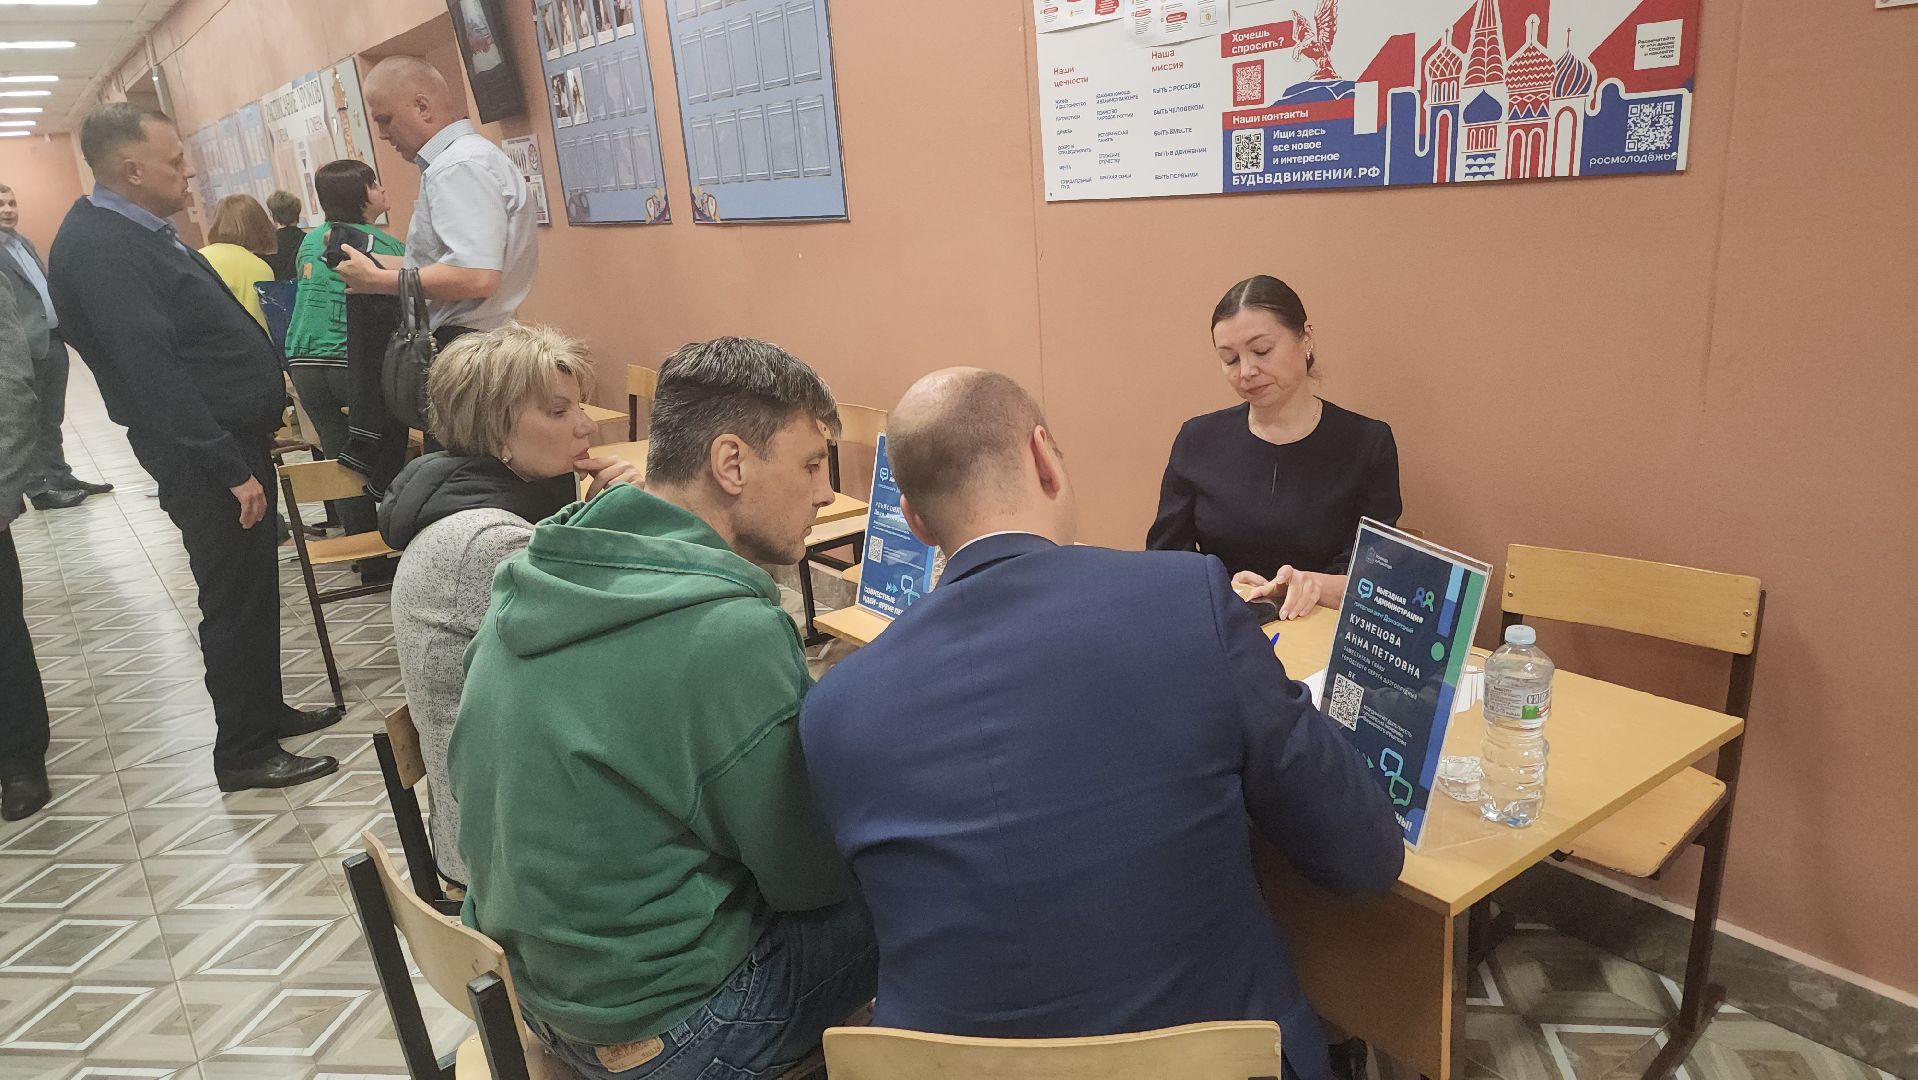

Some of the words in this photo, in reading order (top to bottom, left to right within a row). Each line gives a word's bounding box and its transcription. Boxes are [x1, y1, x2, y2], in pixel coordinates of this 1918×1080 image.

[1232, 30, 1270, 43] Хочешь
[1232, 36, 1284, 54] спросить?
[1151, 49, 1175, 60] Наша
[1053, 66, 1074, 76] Наши
[1151, 61, 1184, 72] миссия
[1054, 76, 1089, 88] ценности
[1169, 104, 1204, 114] ЧЕЛОВЕКОМ
[1232, 114, 1260, 124] Наши
[1261, 110, 1309, 122] контакты
[1273, 129, 1295, 140] Ищи
[1297, 127, 1326, 138] здесь
[1273, 143, 1289, 152] все
[1291, 141, 1322, 150] новое
[1273, 157, 1279, 165] и
[1280, 152, 1340, 165] интересное
[1590, 152, 1671, 168] росмолодёжь
[1232, 166, 1380, 186] БУДЬВДВИЖЕНИИ.РФ
[1376, 586, 1406, 606] ВЫЕЗДНАЯ
[1374, 596, 1424, 624] АДМИНИСТРАЦИЯ
[1350, 613, 1400, 648] КУЗНЕЦОВА
[1345, 632, 1369, 651] АННА
[1371, 644, 1420, 679] ПЕТРОВНА
[1348, 670, 1356, 680] ВК
